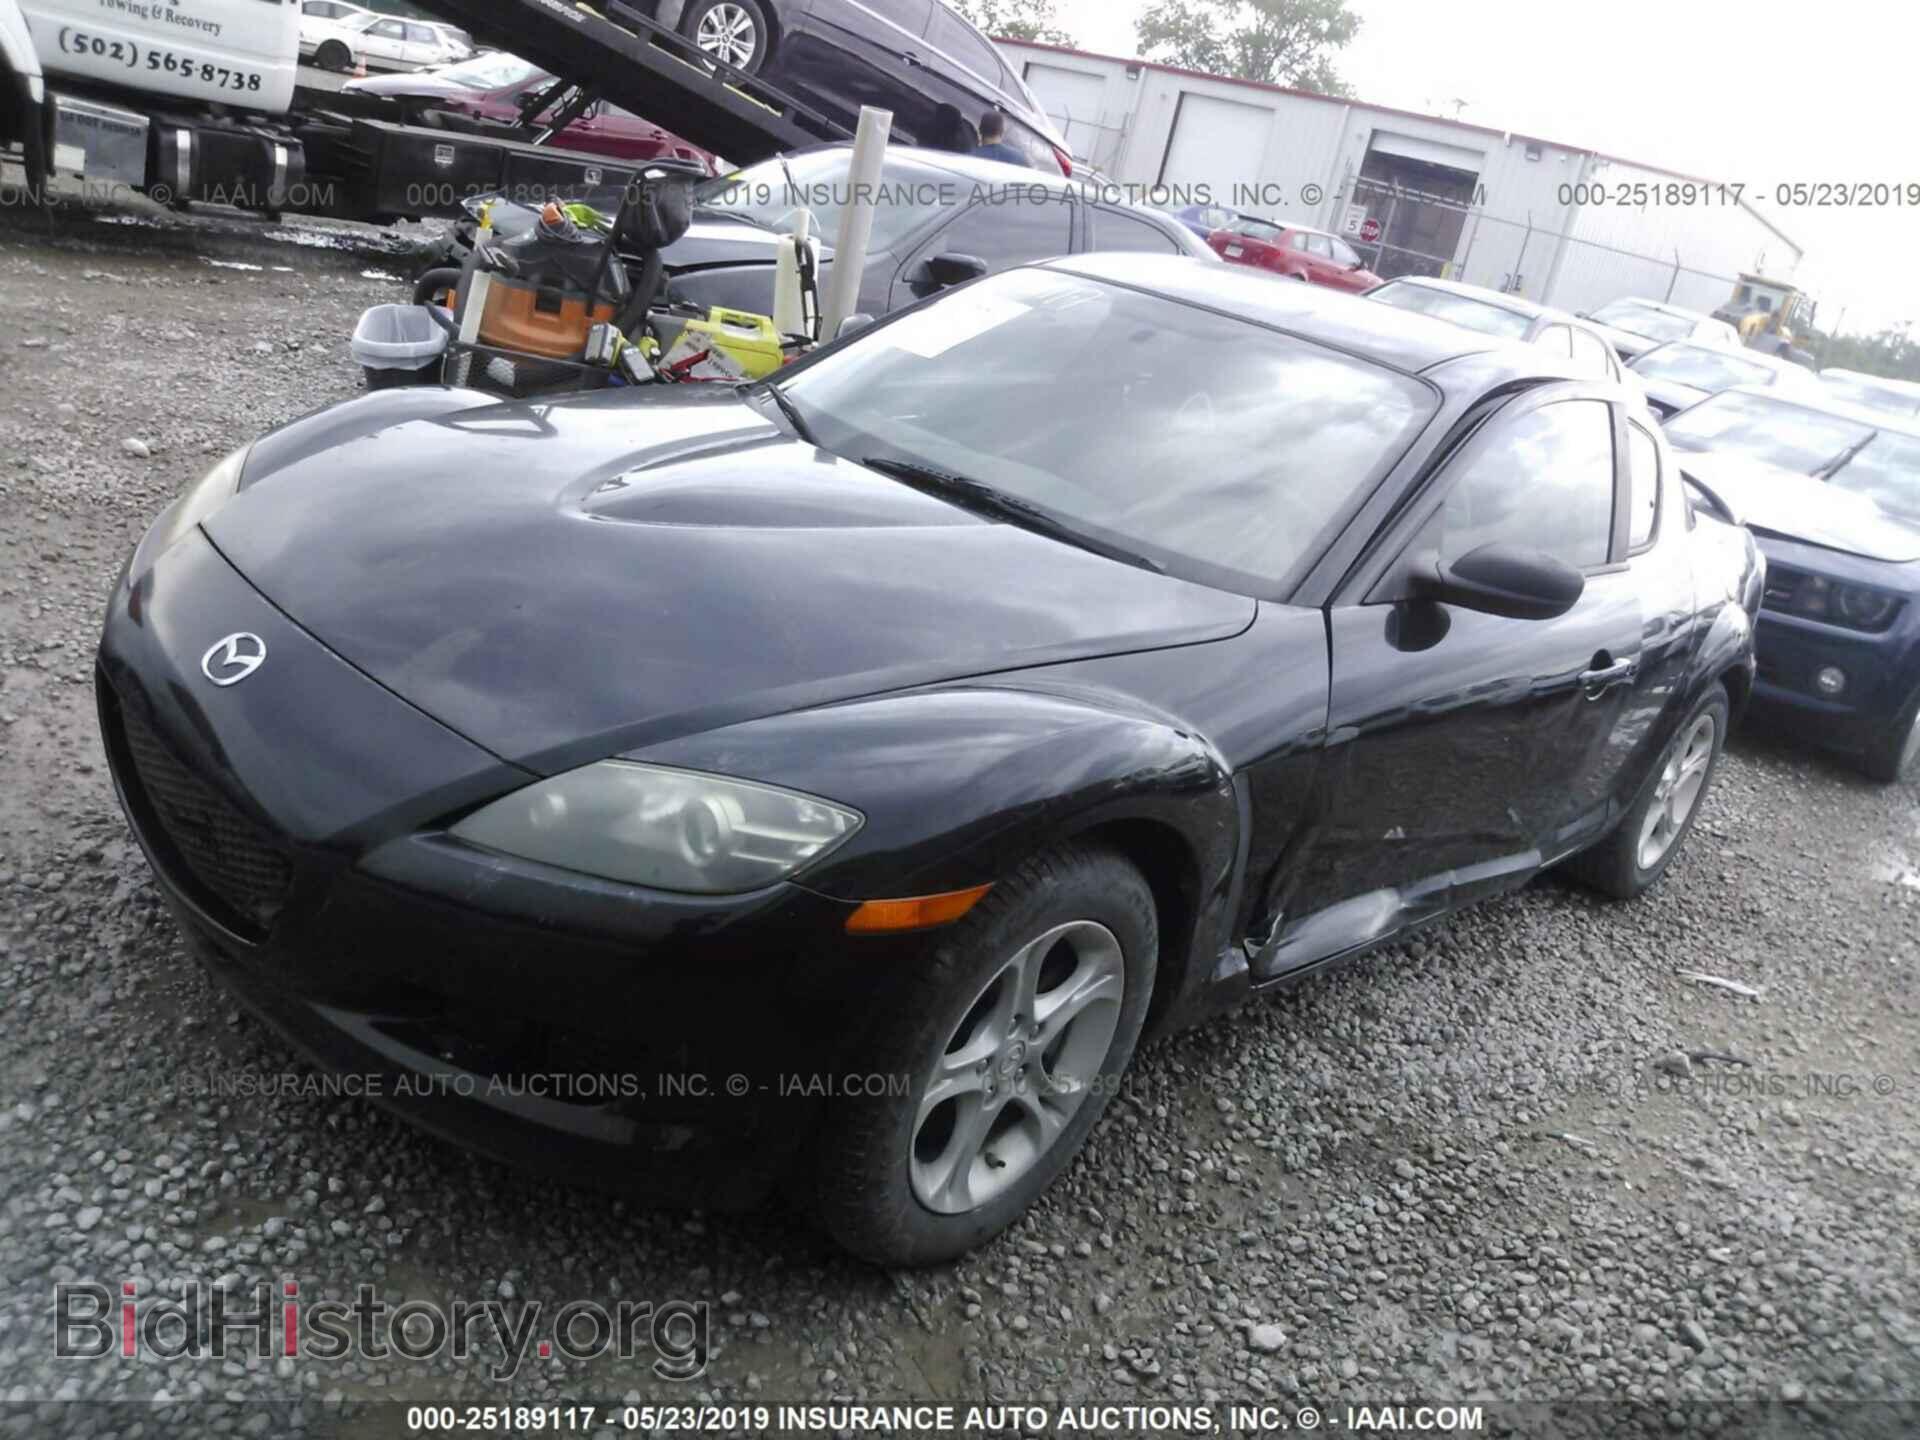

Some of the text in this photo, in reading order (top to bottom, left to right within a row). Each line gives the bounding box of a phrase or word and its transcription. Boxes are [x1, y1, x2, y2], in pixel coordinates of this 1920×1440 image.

[165, 8, 222, 37] Recovery
[59, 27, 138, 68] (502)
[1361, 224, 1379, 238] STOP
